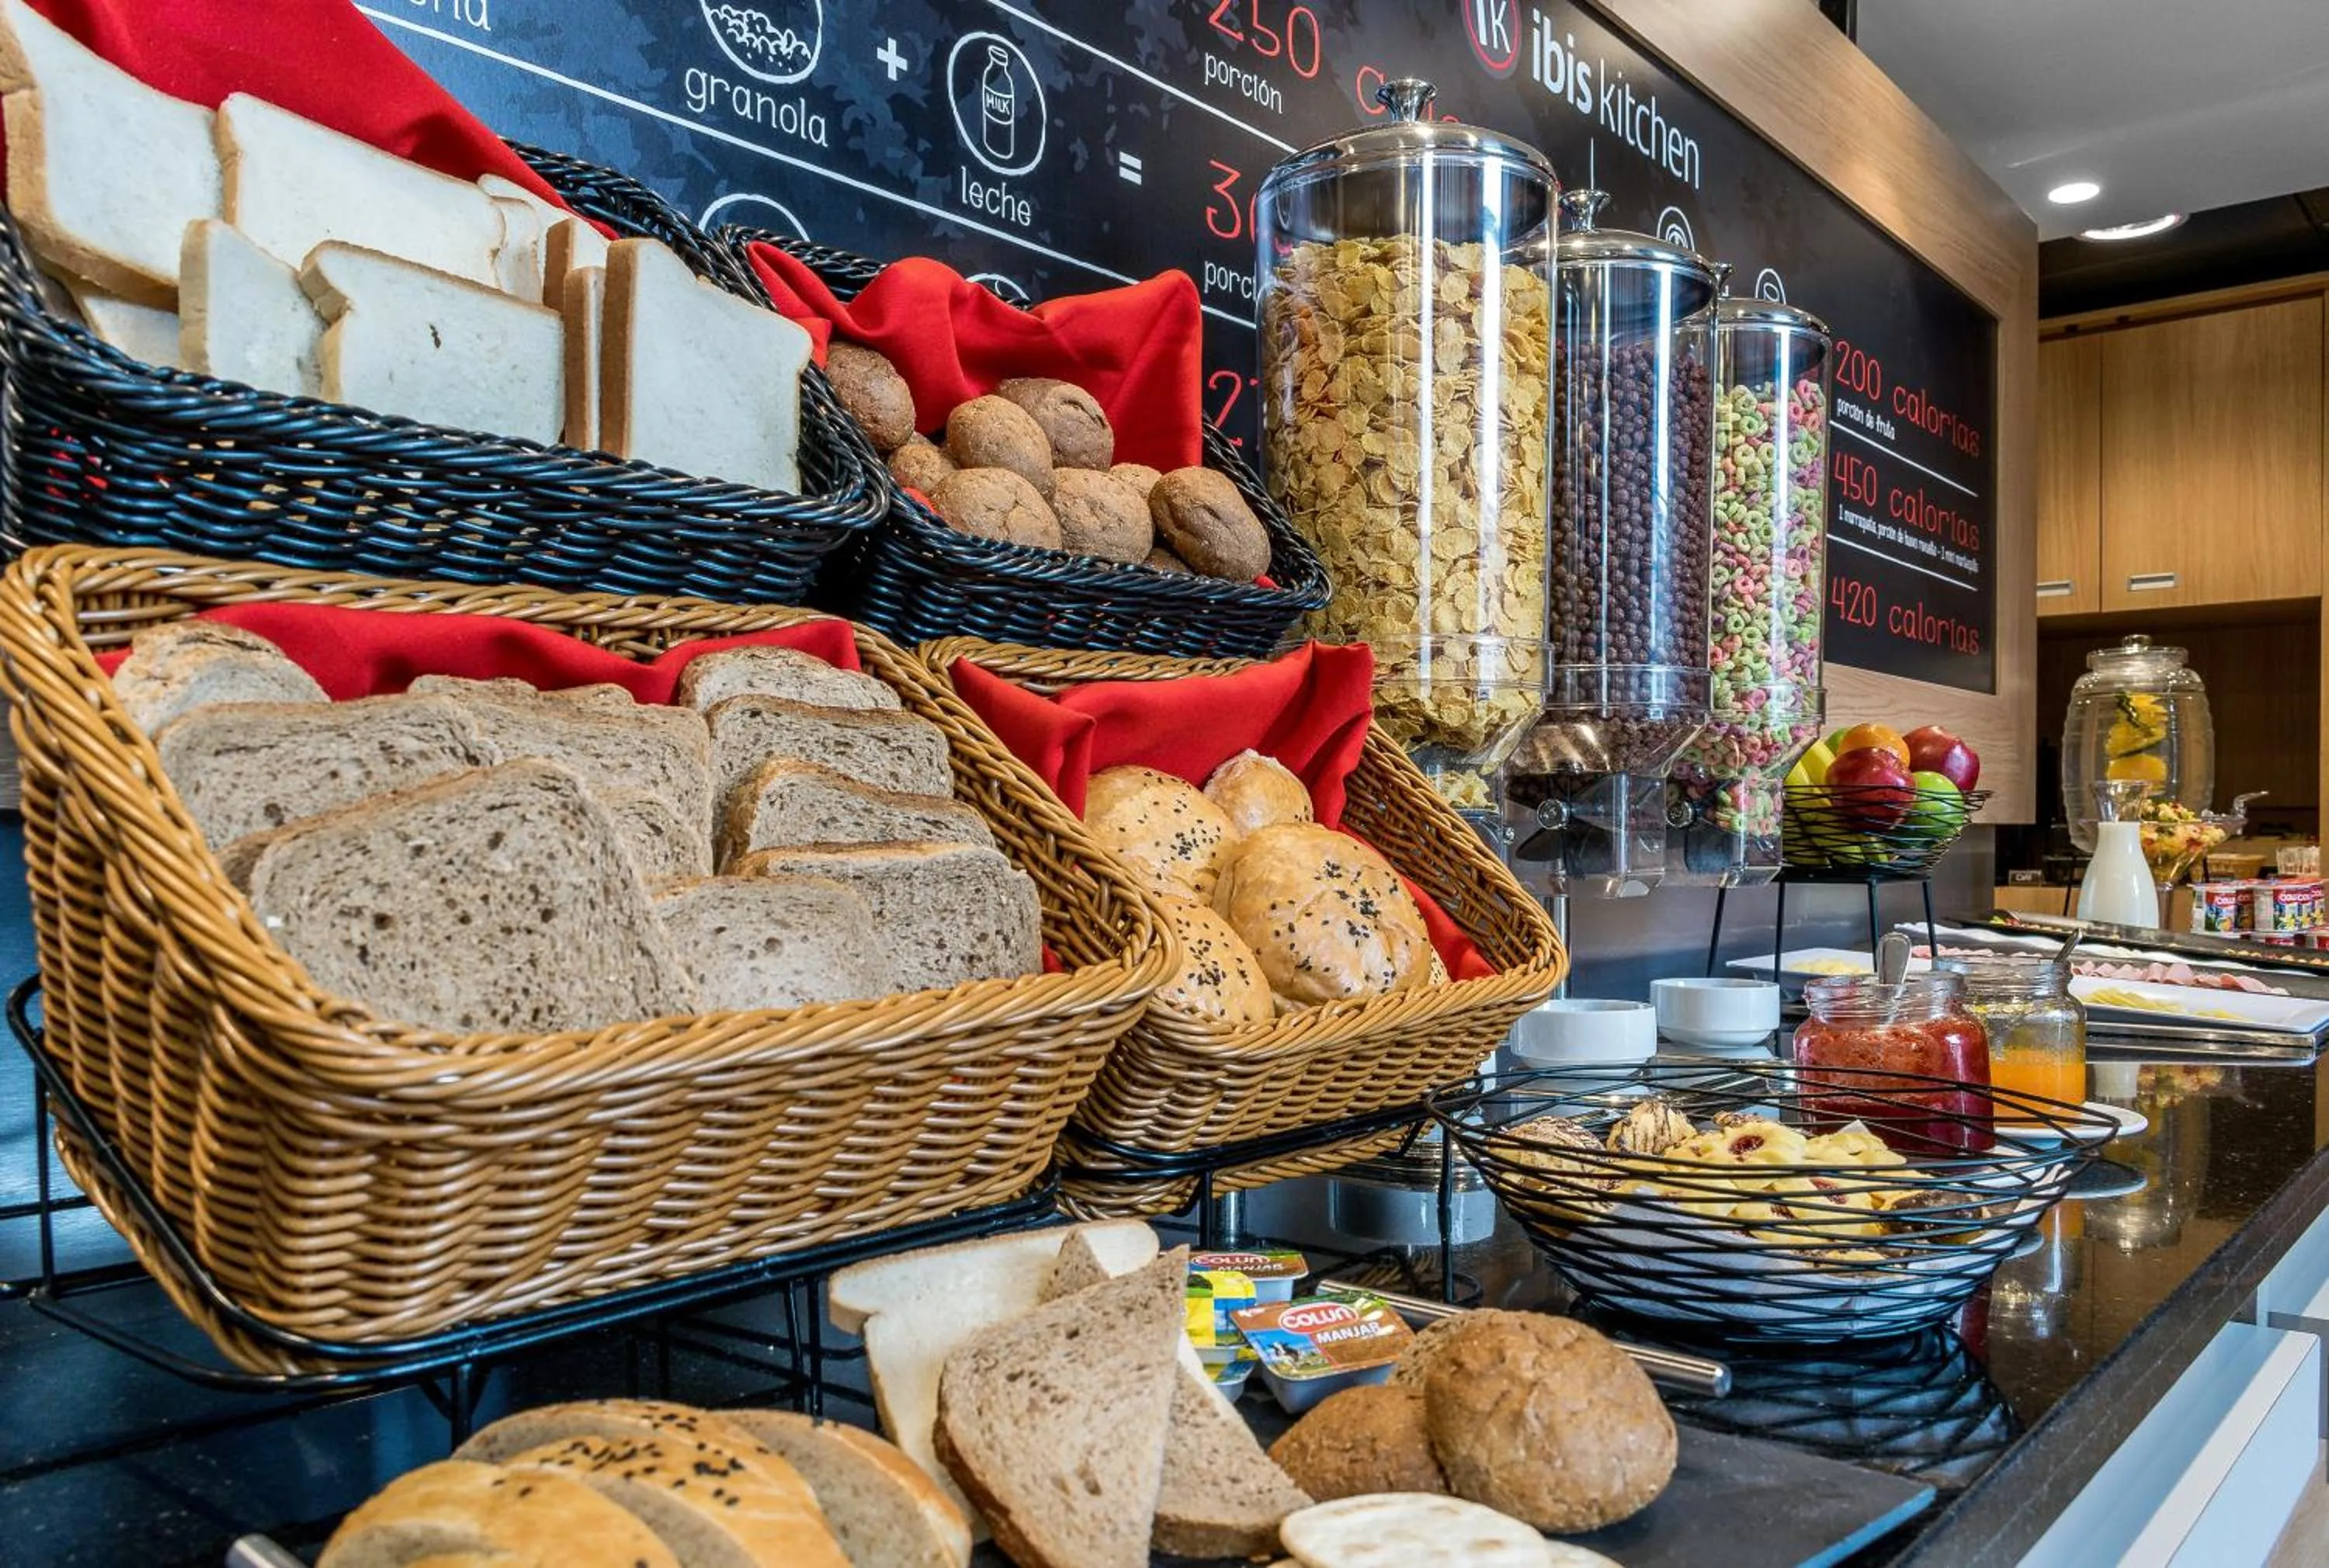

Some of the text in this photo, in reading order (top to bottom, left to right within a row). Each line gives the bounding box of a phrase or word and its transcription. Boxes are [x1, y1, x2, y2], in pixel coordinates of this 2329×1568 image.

[685, 68, 828, 147] granola
[986, 92, 1010, 115] MILK
[1205, 52, 1283, 113] porción
[1532, 8, 1592, 114] ibis
[1598, 57, 1700, 189] kitchen
[960, 166, 1032, 227] leche
[1835, 340, 1882, 401] 200
[1834, 451, 1877, 507] 450
[1831, 577, 1877, 626] 420
[1194, 1255, 1264, 1265] COLUN
[1283, 1306, 1352, 1328] COLUN
[1316, 1322, 1380, 1343] MANJAR
